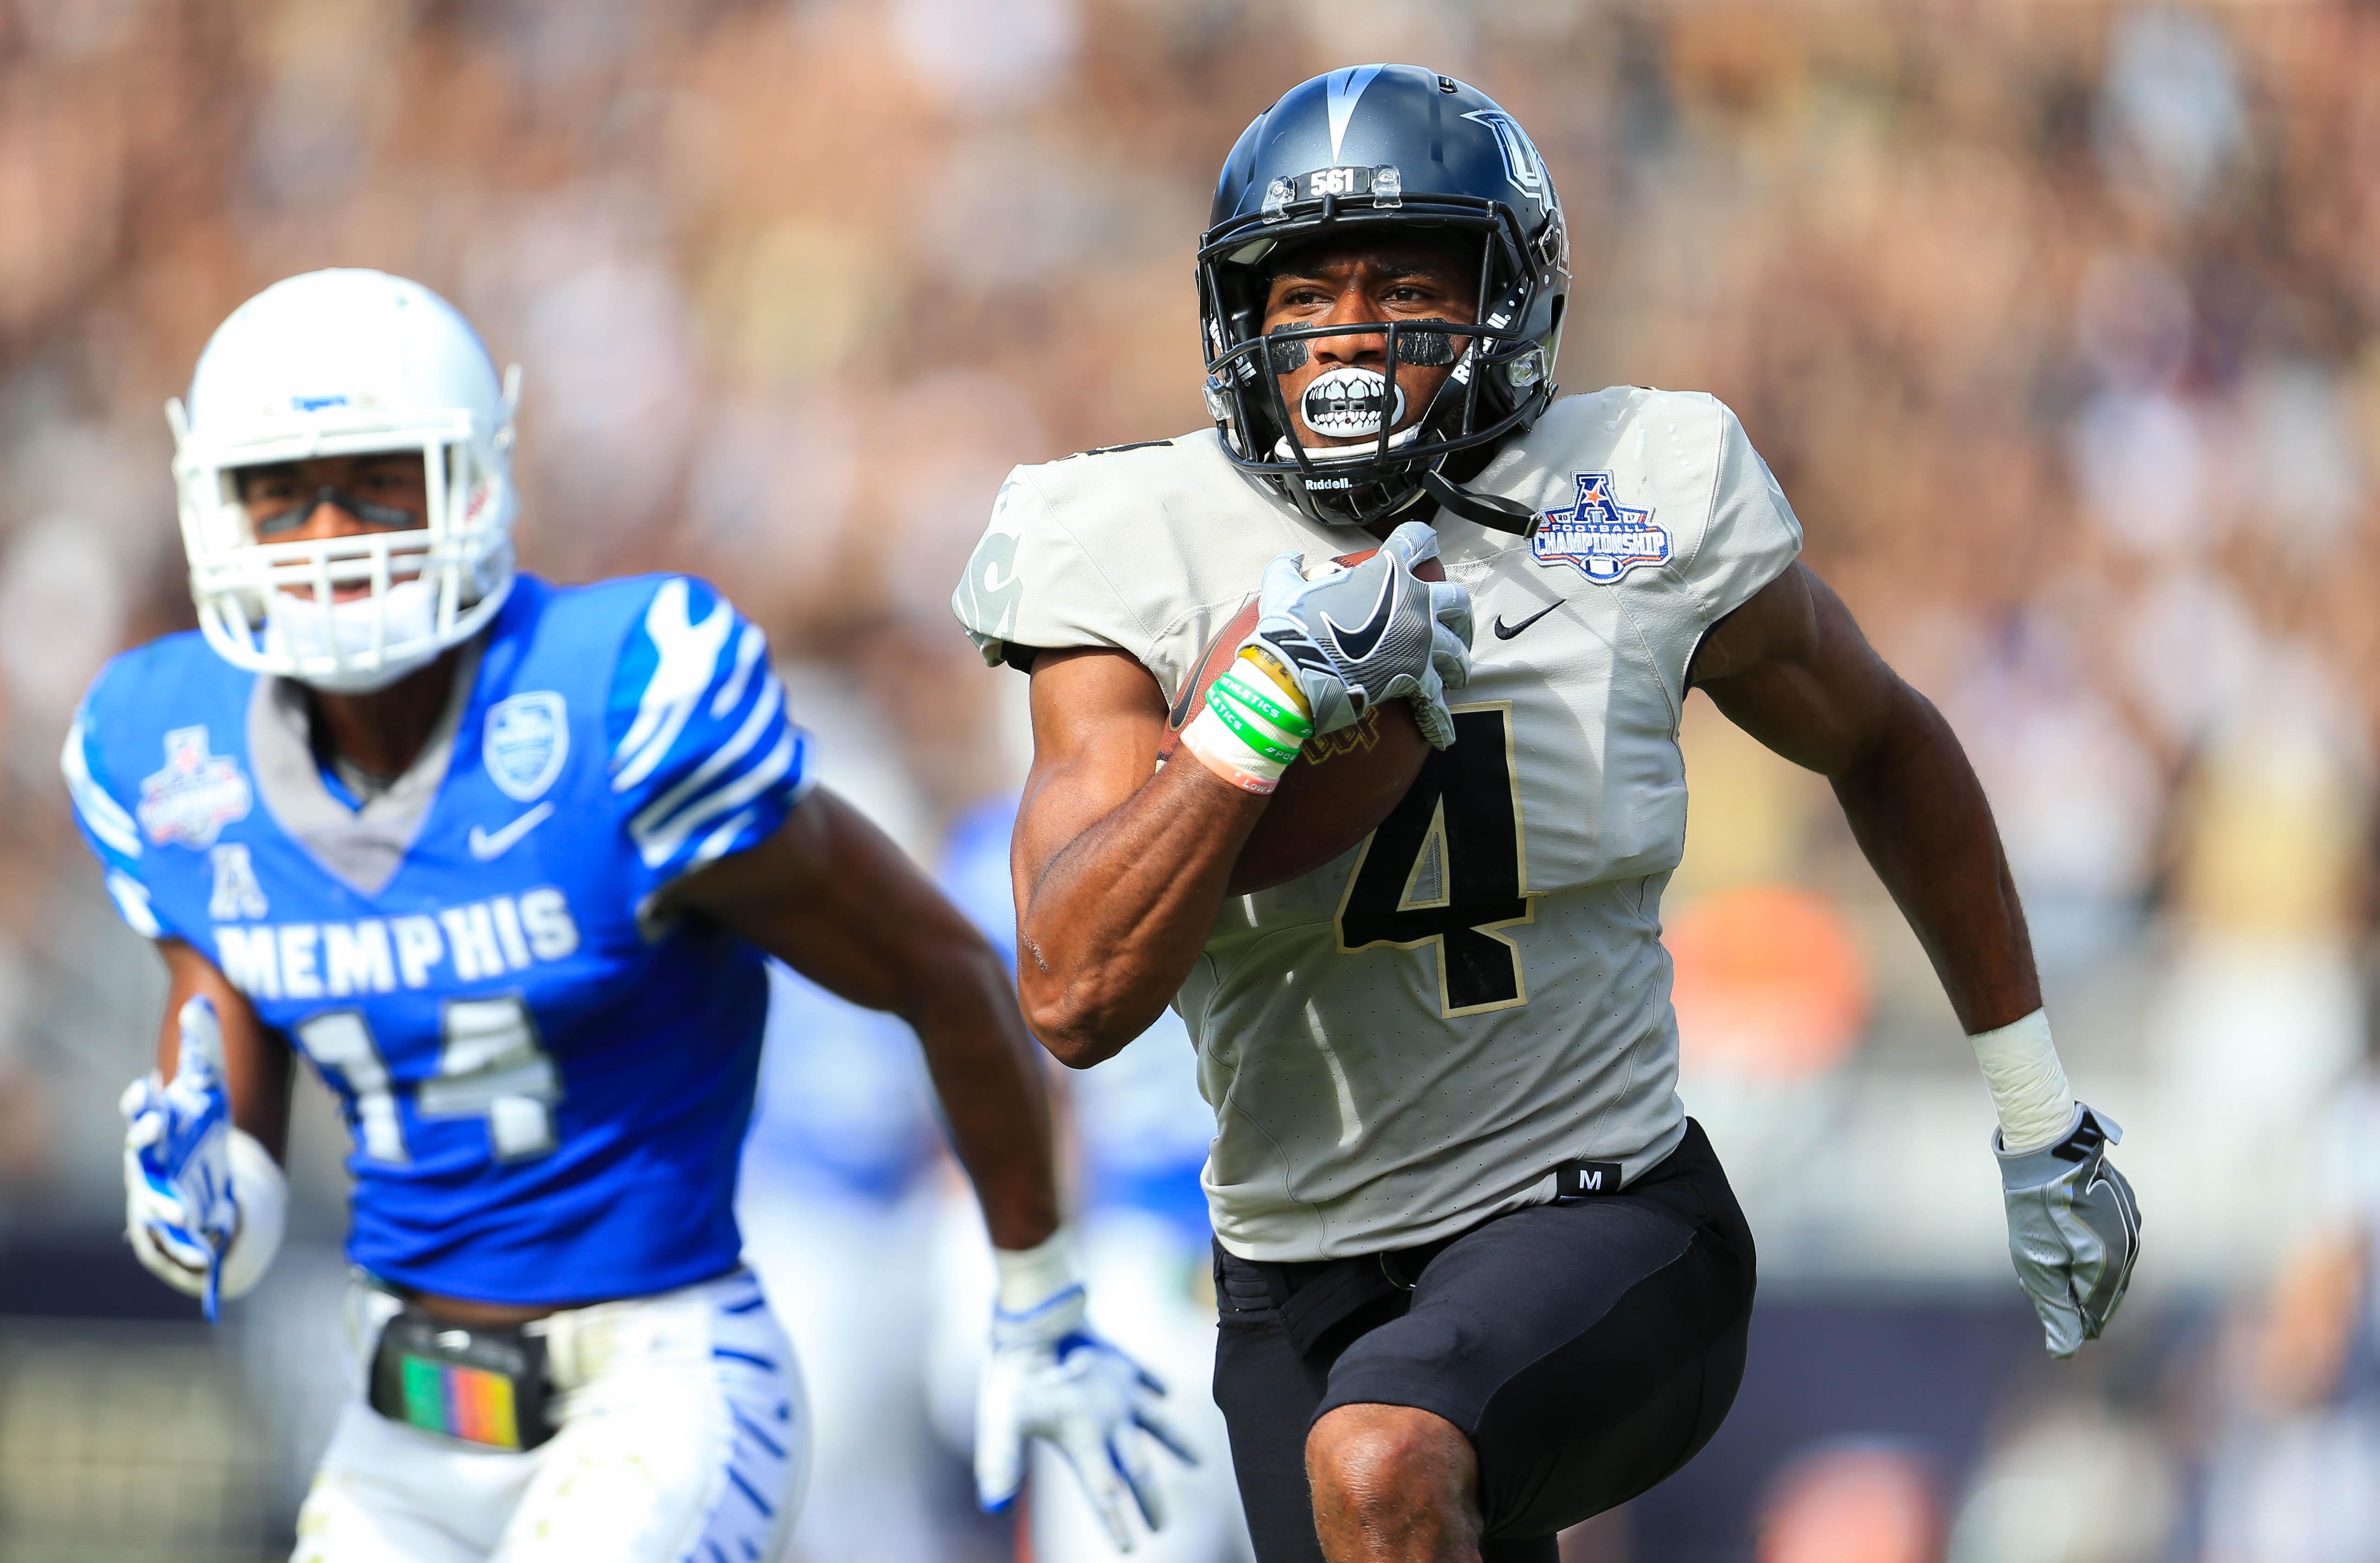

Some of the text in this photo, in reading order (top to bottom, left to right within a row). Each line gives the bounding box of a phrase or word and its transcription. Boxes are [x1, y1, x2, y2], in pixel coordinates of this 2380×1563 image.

[1311, 169, 1353, 196] 561
[1534, 532, 1665, 555] CHAMPIONSHIP
[1333, 699, 1534, 1019] 4
[213, 886, 580, 1000] MEMPHIS
[296, 992, 561, 1163] 14
[1579, 1170, 1602, 1190] M
